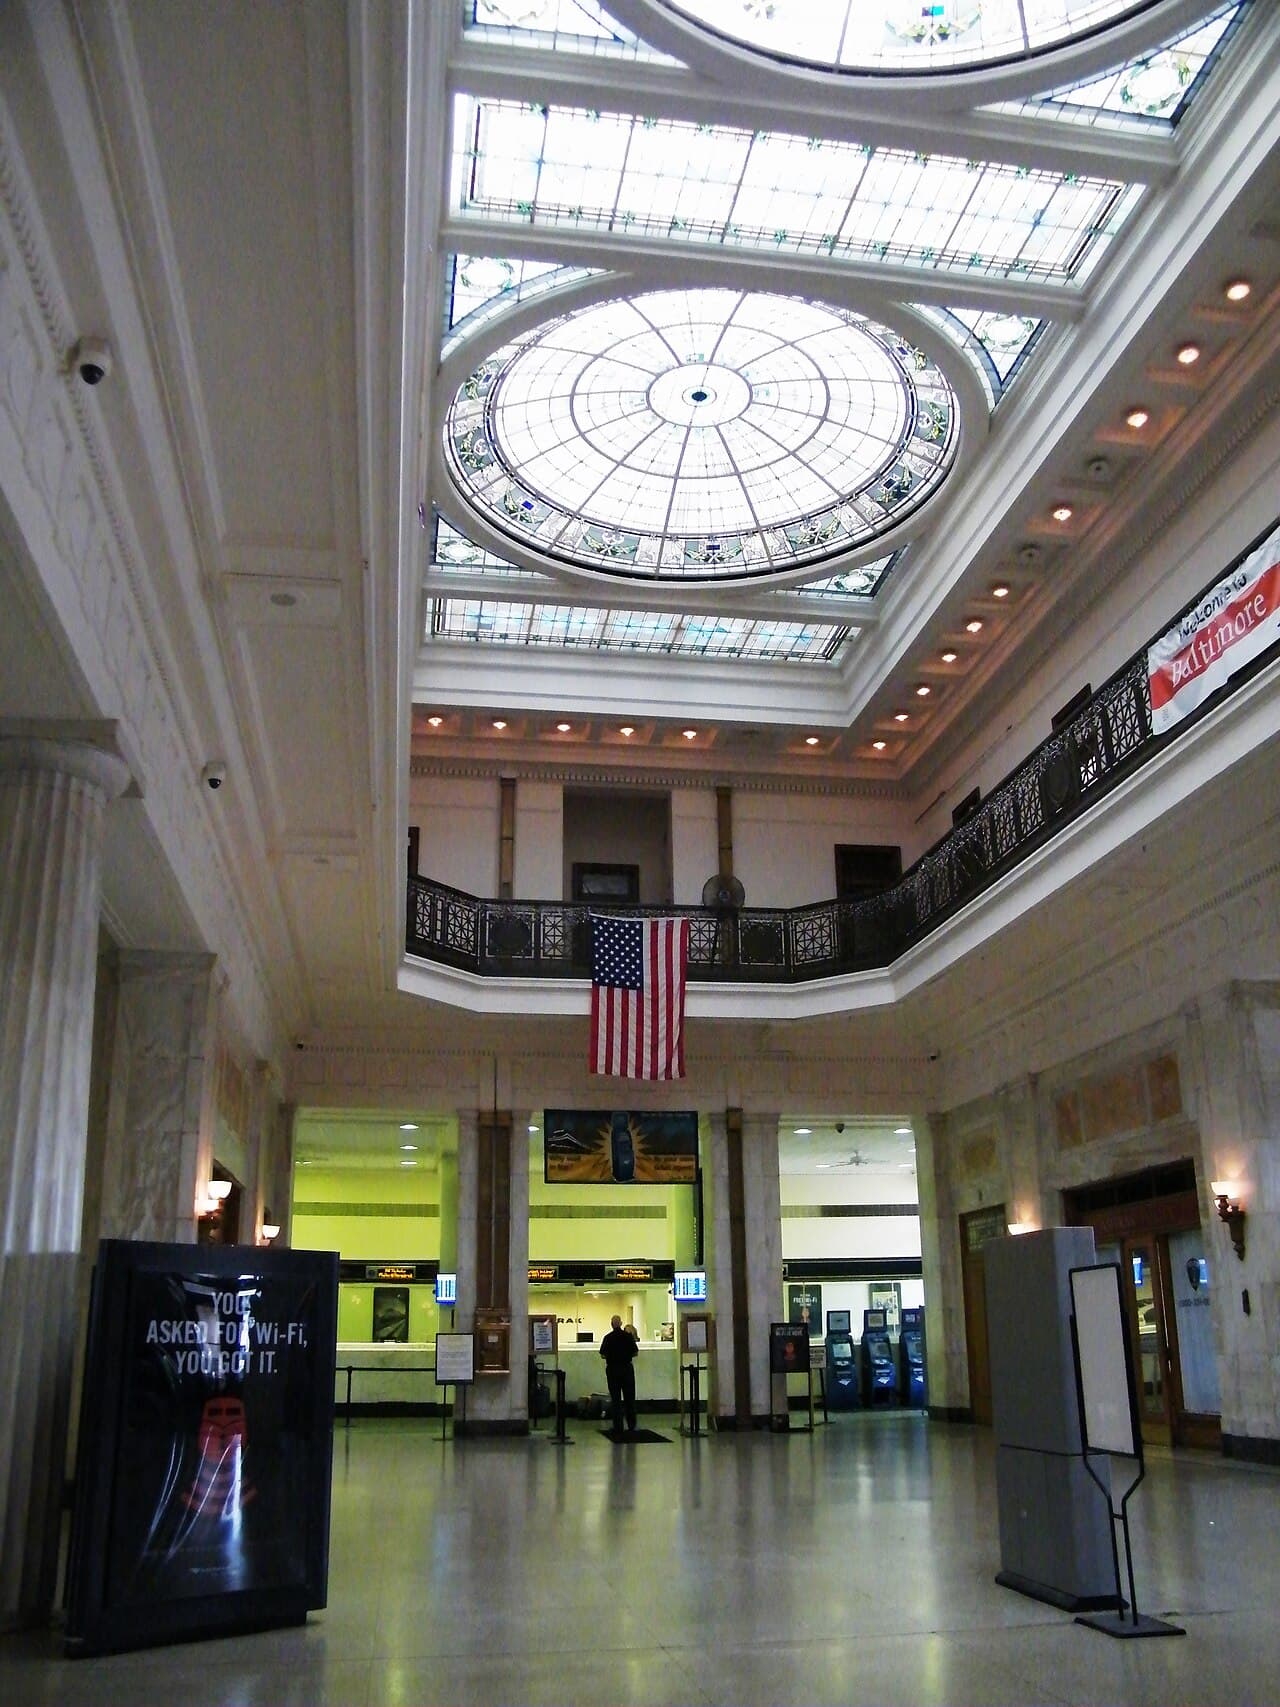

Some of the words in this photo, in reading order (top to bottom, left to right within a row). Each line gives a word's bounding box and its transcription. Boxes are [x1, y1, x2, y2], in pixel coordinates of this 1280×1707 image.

[1178, 587, 1231, 637] Welcome
[1171, 593, 1267, 689] Baltimore
[146, 1319, 208, 1344] ASKED
[256, 1321, 308, 1348] Wi-Fi,
[176, 1351, 213, 1374] YOU
[217, 1351, 253, 1374] GOT
[259, 1351, 278, 1374] IT.
